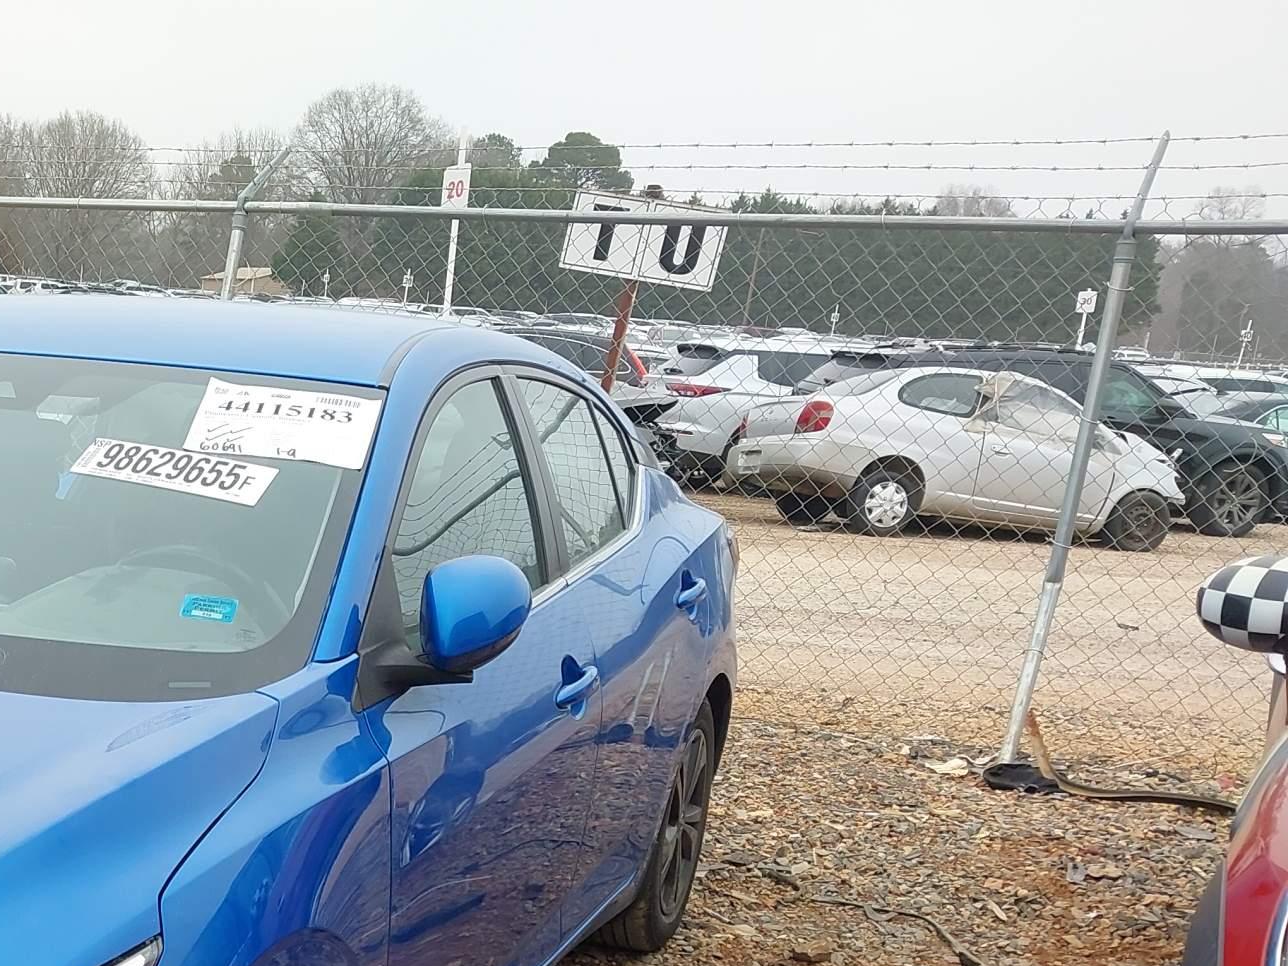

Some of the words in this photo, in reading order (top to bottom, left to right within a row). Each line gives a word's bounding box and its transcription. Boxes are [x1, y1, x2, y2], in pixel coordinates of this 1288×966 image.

[446, 180, 464, 200] 20
[1079, 297, 1093, 306] 30
[218, 399, 353, 424] 44115183
